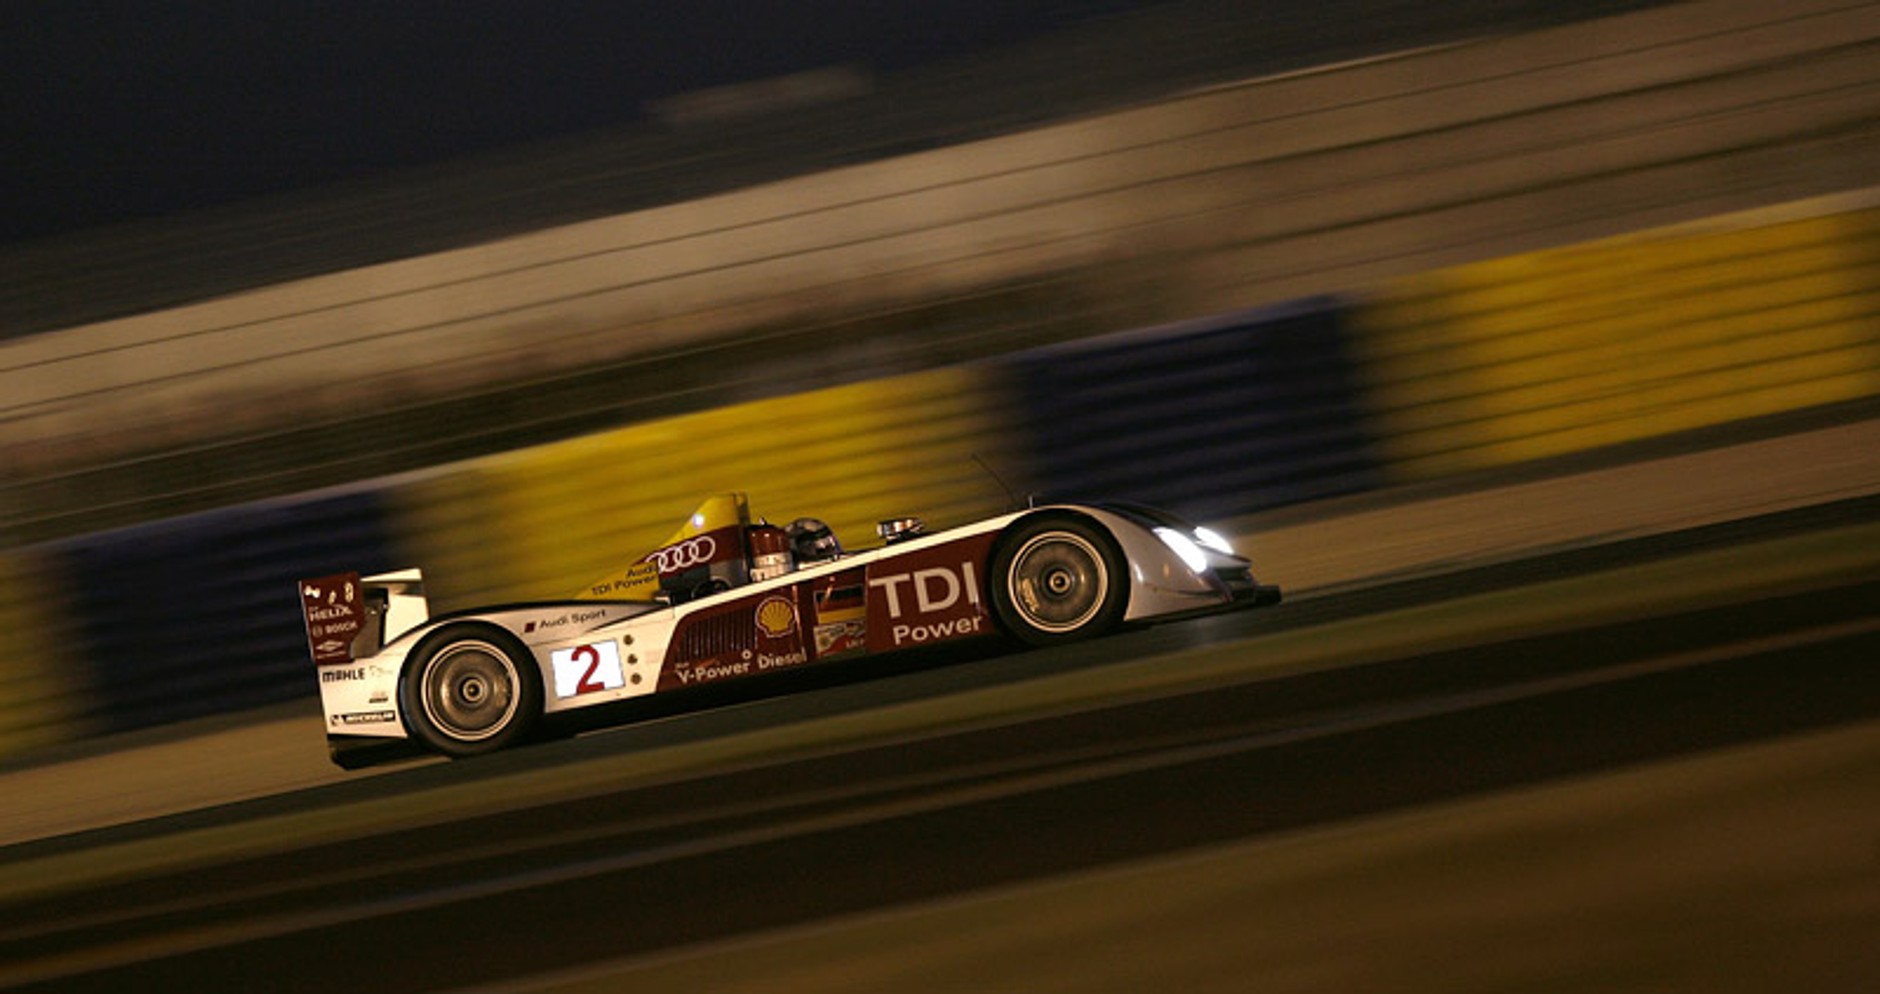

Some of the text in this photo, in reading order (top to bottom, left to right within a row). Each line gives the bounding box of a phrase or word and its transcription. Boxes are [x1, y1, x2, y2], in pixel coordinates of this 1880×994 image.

[627, 564, 656, 578] Audi
[592, 575, 655, 595] TDI Power
[868, 561, 980, 619] TDI
[309, 604, 353, 622] HELIX
[539, 609, 606, 628] Audi Sport
[325, 620, 357, 633] BOSCH
[892, 615, 983, 645] Power
[571, 644, 605, 696] 2
[675, 646, 807, 684] V-Power Diesel
